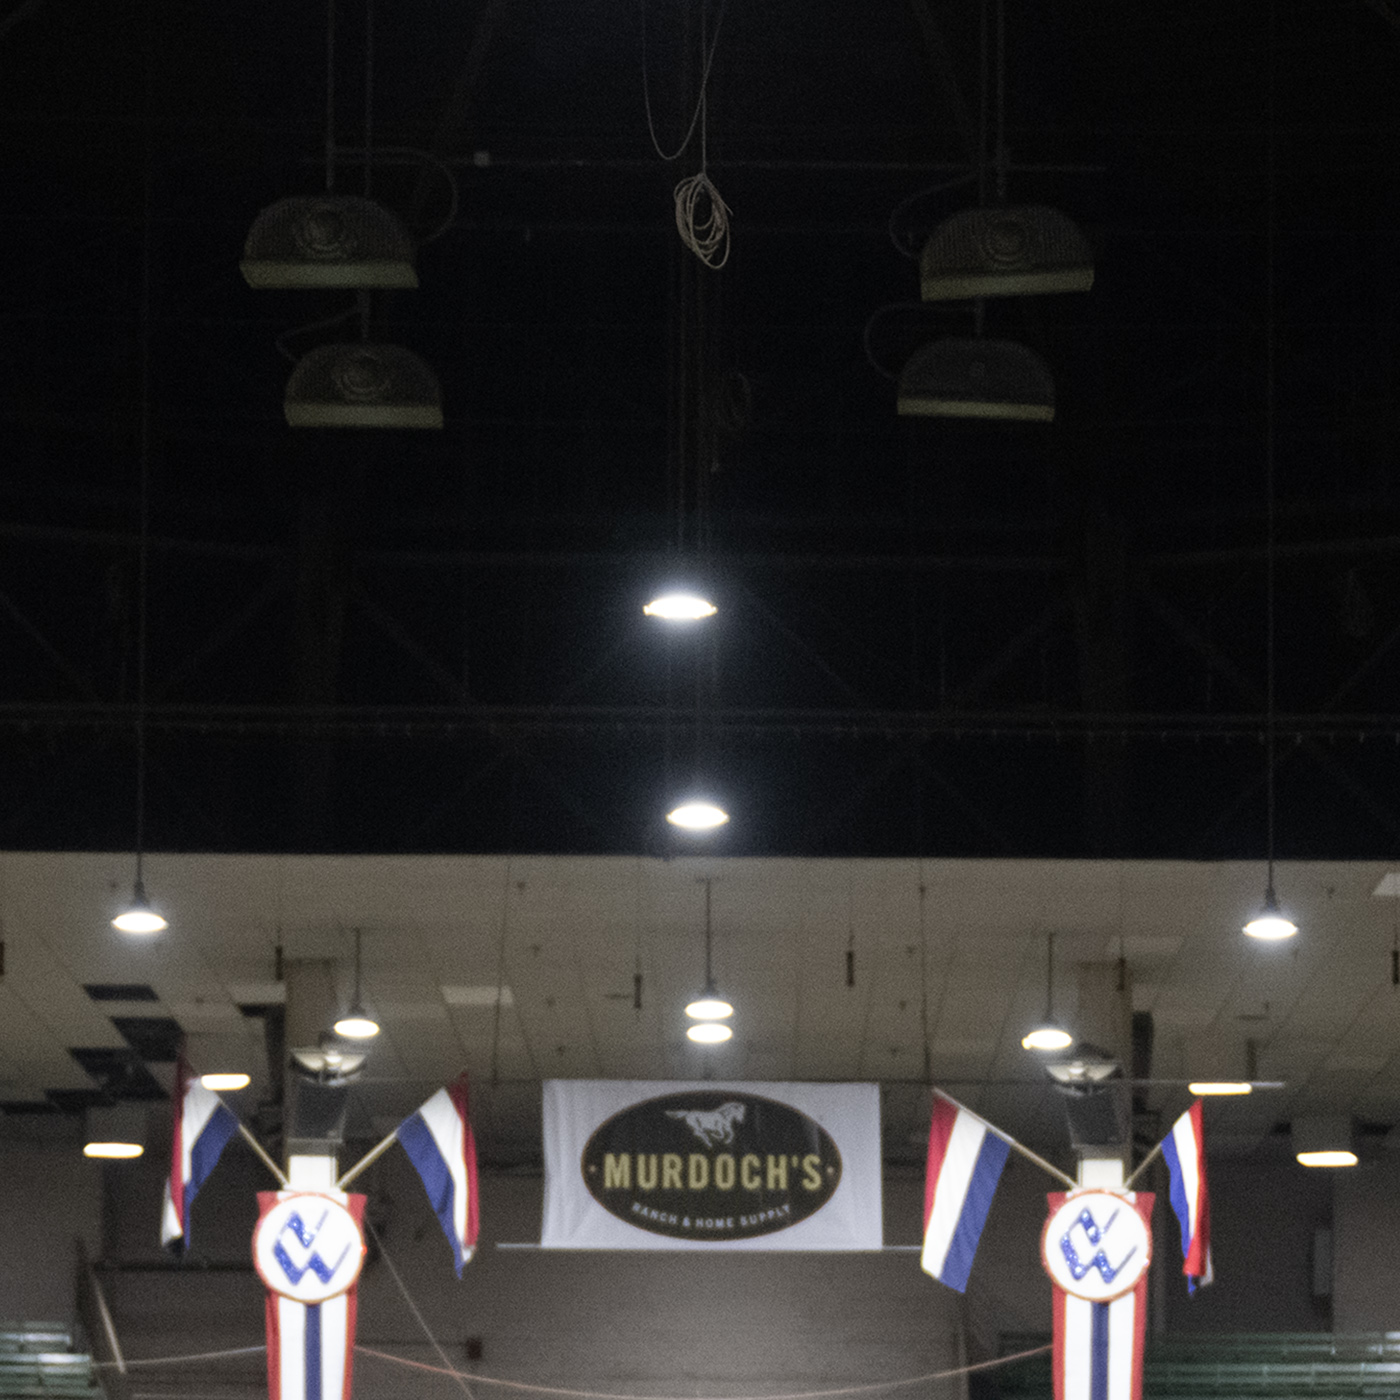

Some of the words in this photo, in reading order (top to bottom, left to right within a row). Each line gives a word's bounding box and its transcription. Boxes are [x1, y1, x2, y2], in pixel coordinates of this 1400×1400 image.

[603, 1152, 823, 1191] MURDOCH'S
[631, 1202, 678, 1225] RANCH
[682, 1216, 692, 1228] &
[695, 1217, 735, 1229] HOME
[740, 1203, 791, 1227] SUPPLY
